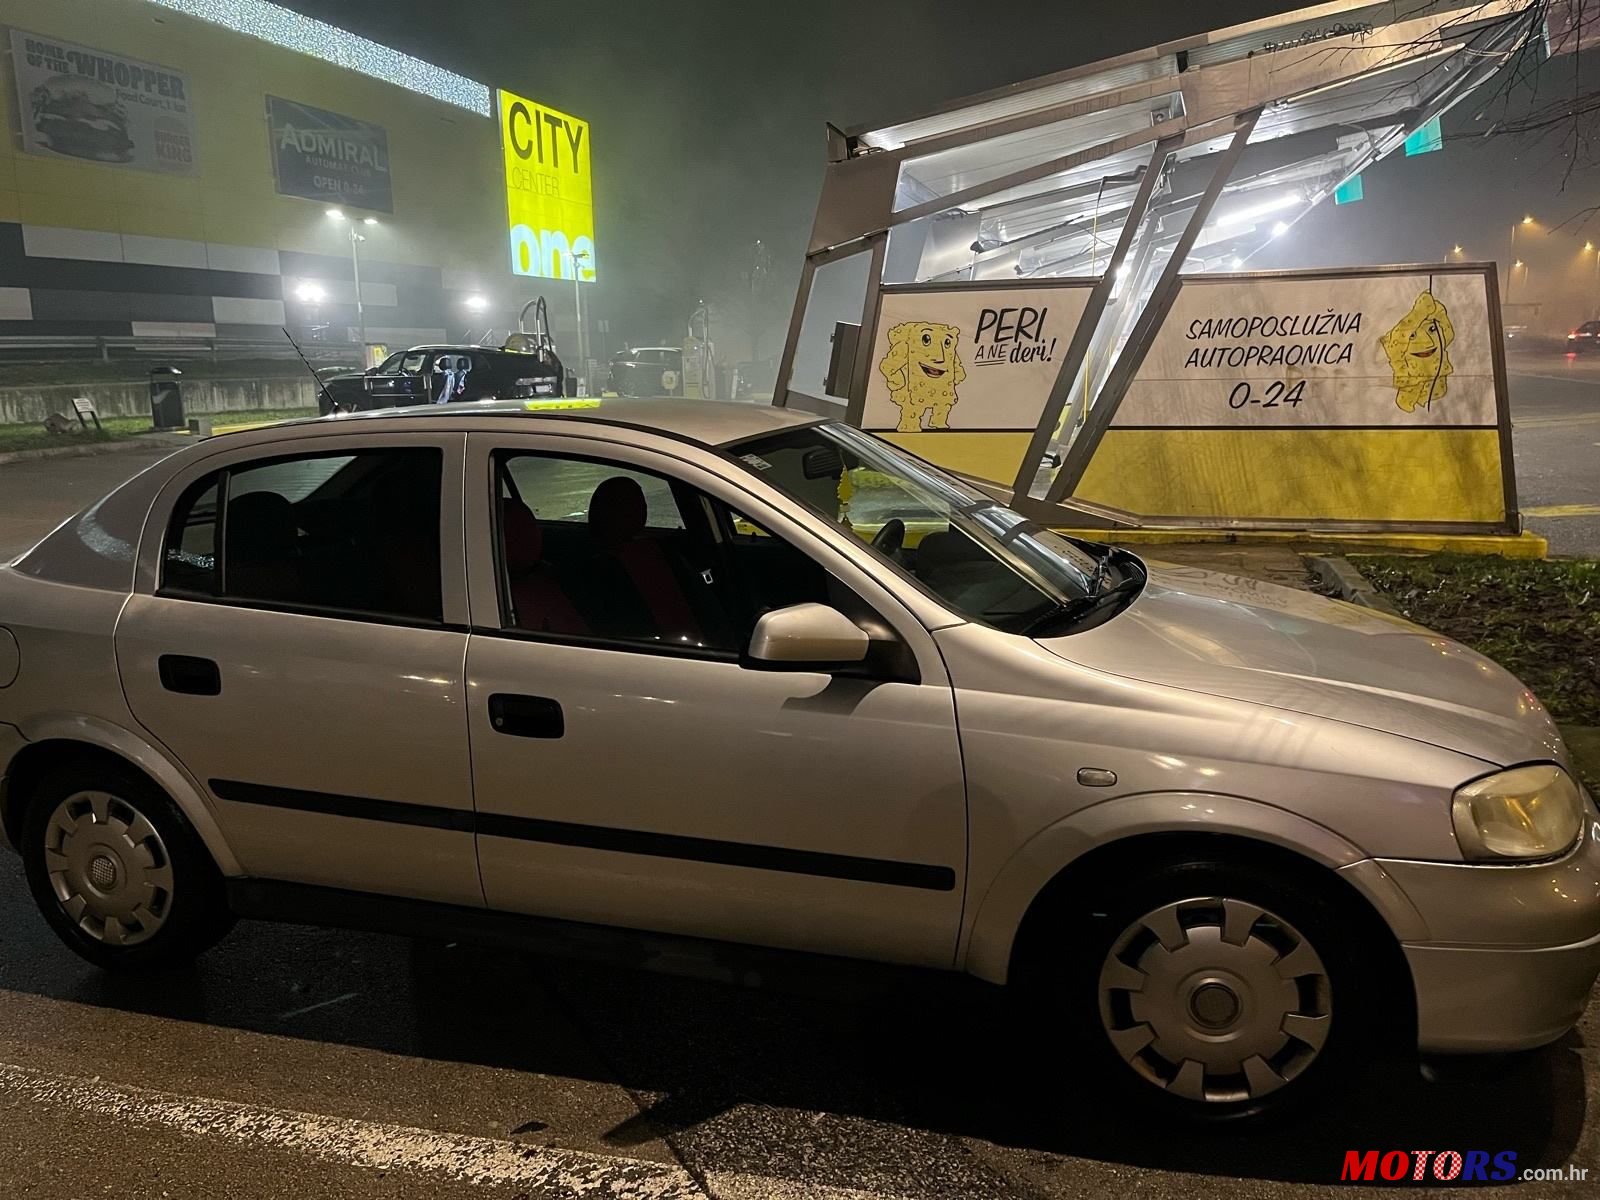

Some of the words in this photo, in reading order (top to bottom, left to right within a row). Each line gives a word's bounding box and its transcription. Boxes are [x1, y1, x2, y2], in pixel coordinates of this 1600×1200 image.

[67, 50, 185, 100] WHOPPER
[280, 122, 387, 172] ADMIRAL
[509, 102, 583, 174] CITY
[512, 166, 560, 198] CENTER
[511, 223, 596, 282] one
[974, 307, 1048, 343] PERI
[1185, 308, 1362, 340] SAMOPOSLUŽNA
[974, 344, 985, 360] A
[987, 343, 1007, 359] NE
[1009, 338, 1057, 363] deri!
[1184, 342, 1354, 369] AUTOPRAONICA
[1228, 380, 1306, 409] 0-24
